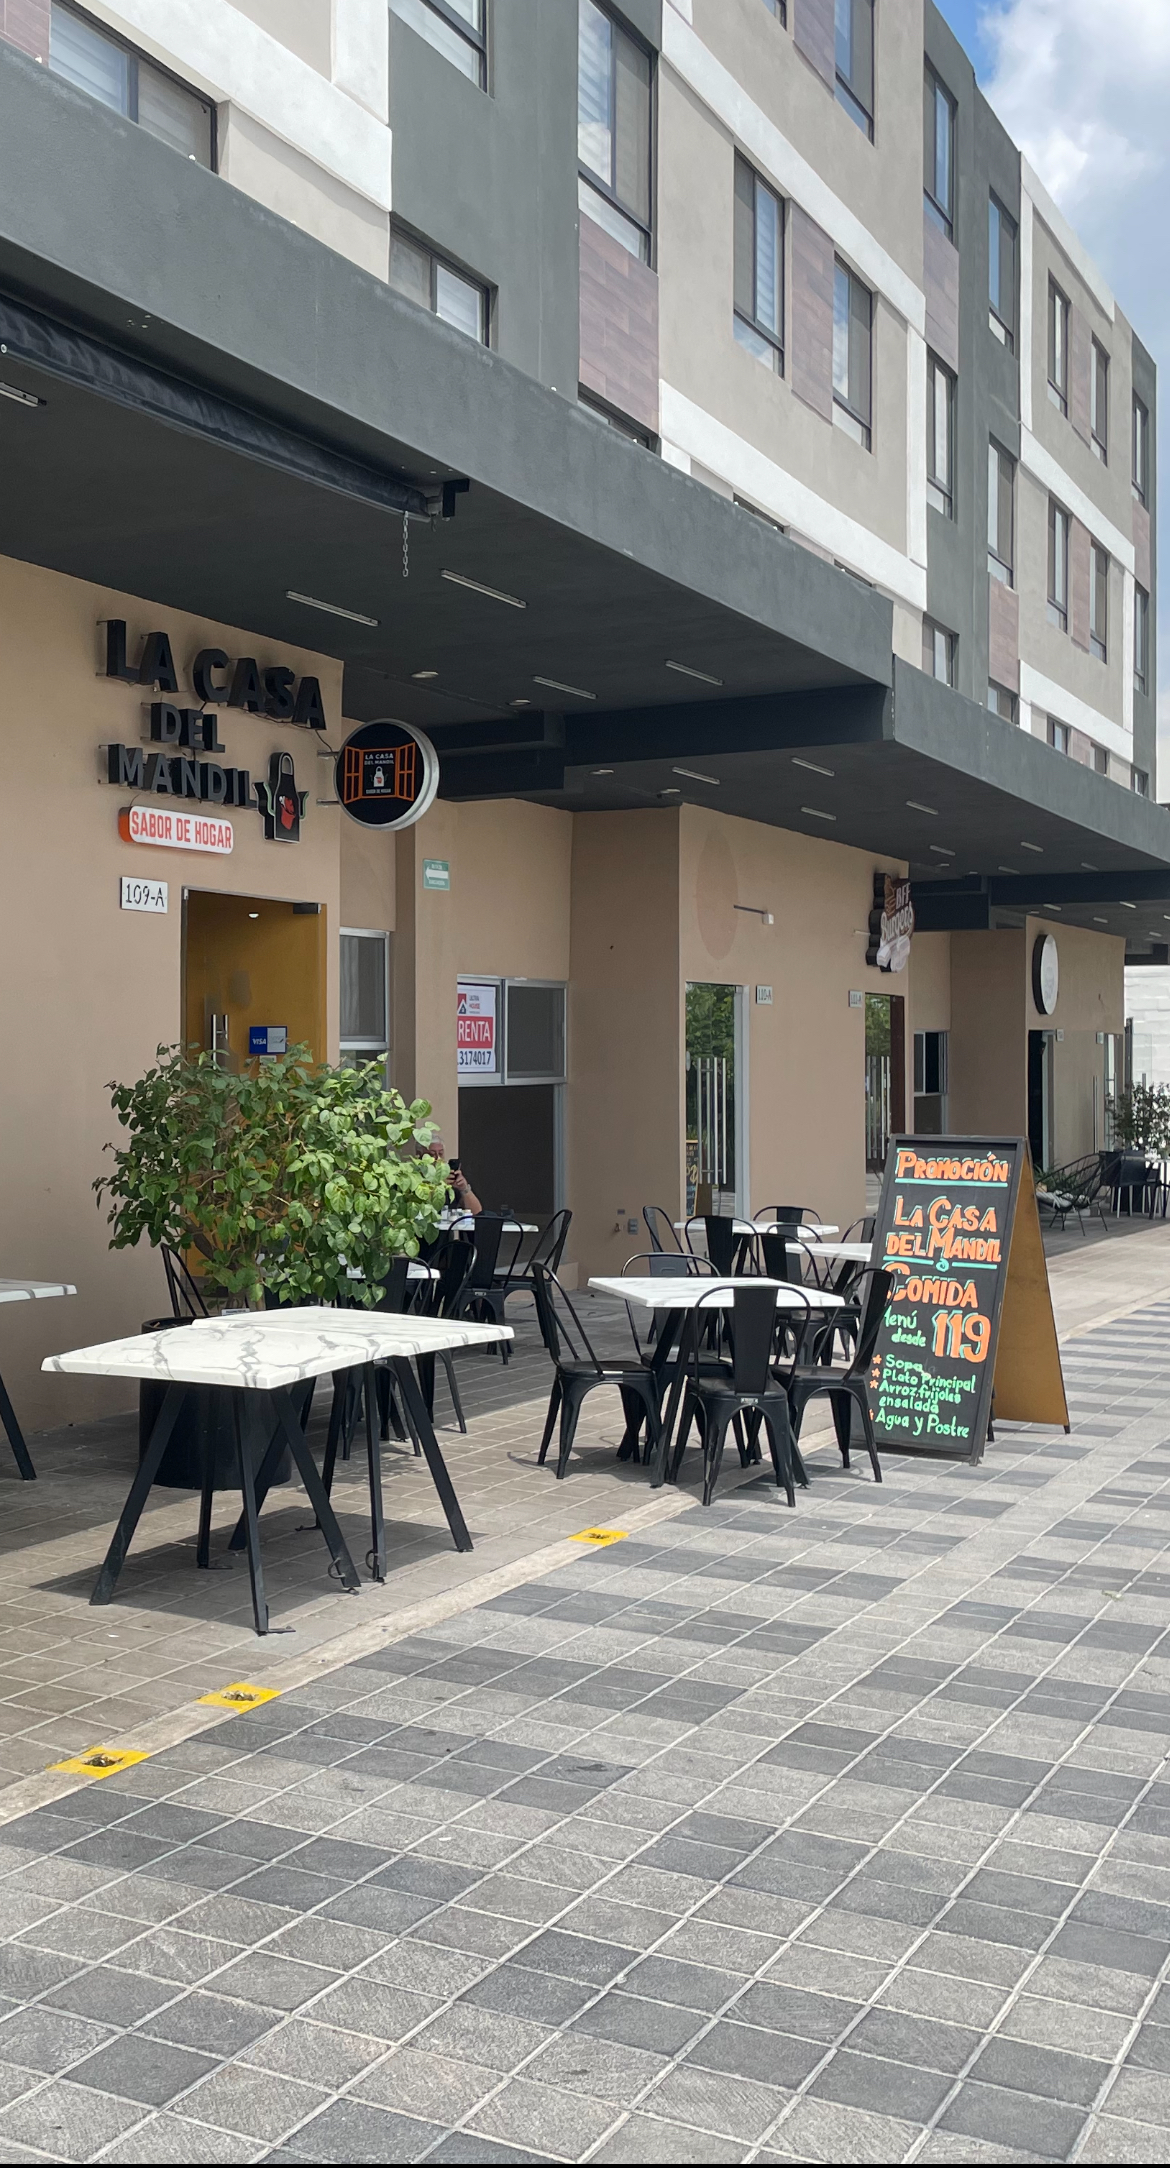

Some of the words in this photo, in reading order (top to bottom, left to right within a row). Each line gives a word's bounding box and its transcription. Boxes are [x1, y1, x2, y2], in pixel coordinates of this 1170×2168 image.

[107, 619, 178, 693] LA
[193, 648, 327, 730] CASA
[151, 702, 225, 753] DEL
[108, 744, 258, 810] MANDIL
[131, 811, 172, 840] SABOR
[176, 818, 191, 842] DE
[195, 821, 232, 848] HOGAR
[125, 883, 165, 907] 109-A
[458, 1020, 491, 1042] RENTA
[457, 1050, 492, 1066] 3174017
[886, 1232, 927, 1257] DEL
[891, 1327, 926, 1347] desde
[931, 1310, 991, 1363] 119
[885, 1354, 923, 1372] Sopa
[882, 1368, 918, 1385] Plato
[921, 1372, 976, 1393] Principal
[879, 1396, 939, 1414] ensalada
[875, 1407, 910, 1430] Agua
[912, 1416, 924, 1436] y
[927, 1414, 969, 1438] Postre
